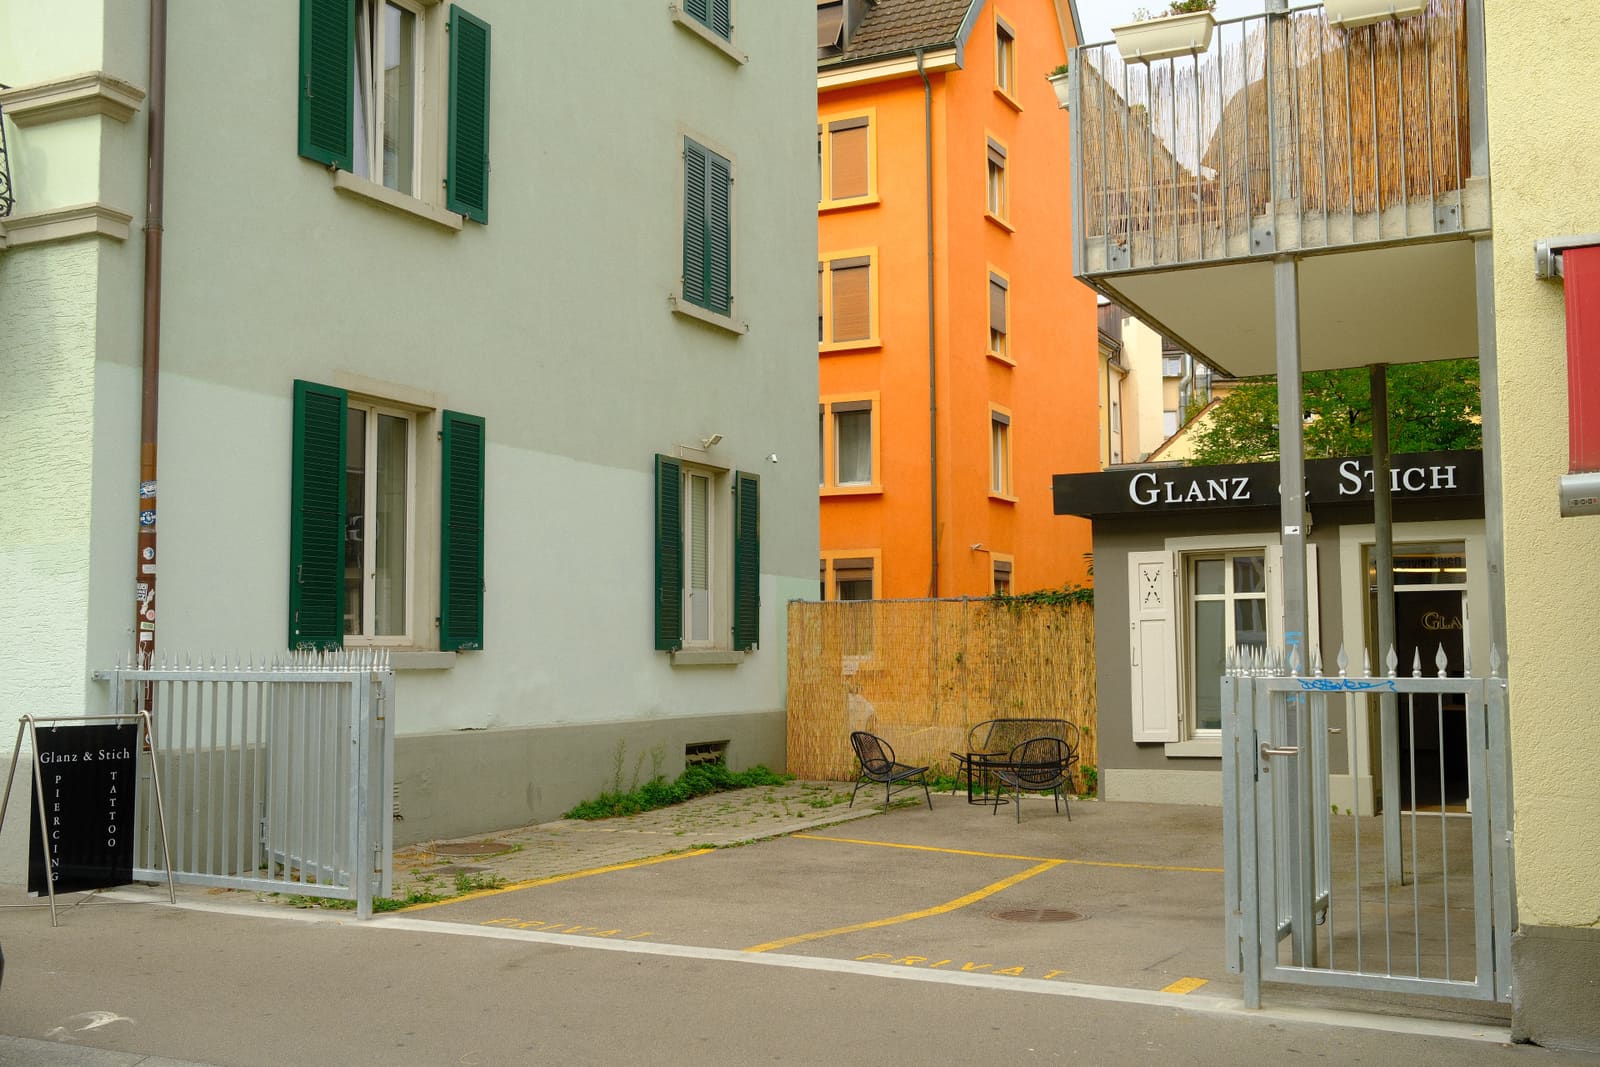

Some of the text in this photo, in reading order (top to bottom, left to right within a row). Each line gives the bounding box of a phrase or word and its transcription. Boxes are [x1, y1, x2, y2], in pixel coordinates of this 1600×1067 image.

[1129, 472, 1250, 505] GLANZ
[1338, 460, 1457, 495] STICH
[40, 747, 130, 764] Glanz & Stich
[51, 775, 62, 881] PIERCING
[107, 771, 118, 847] TATTOO
